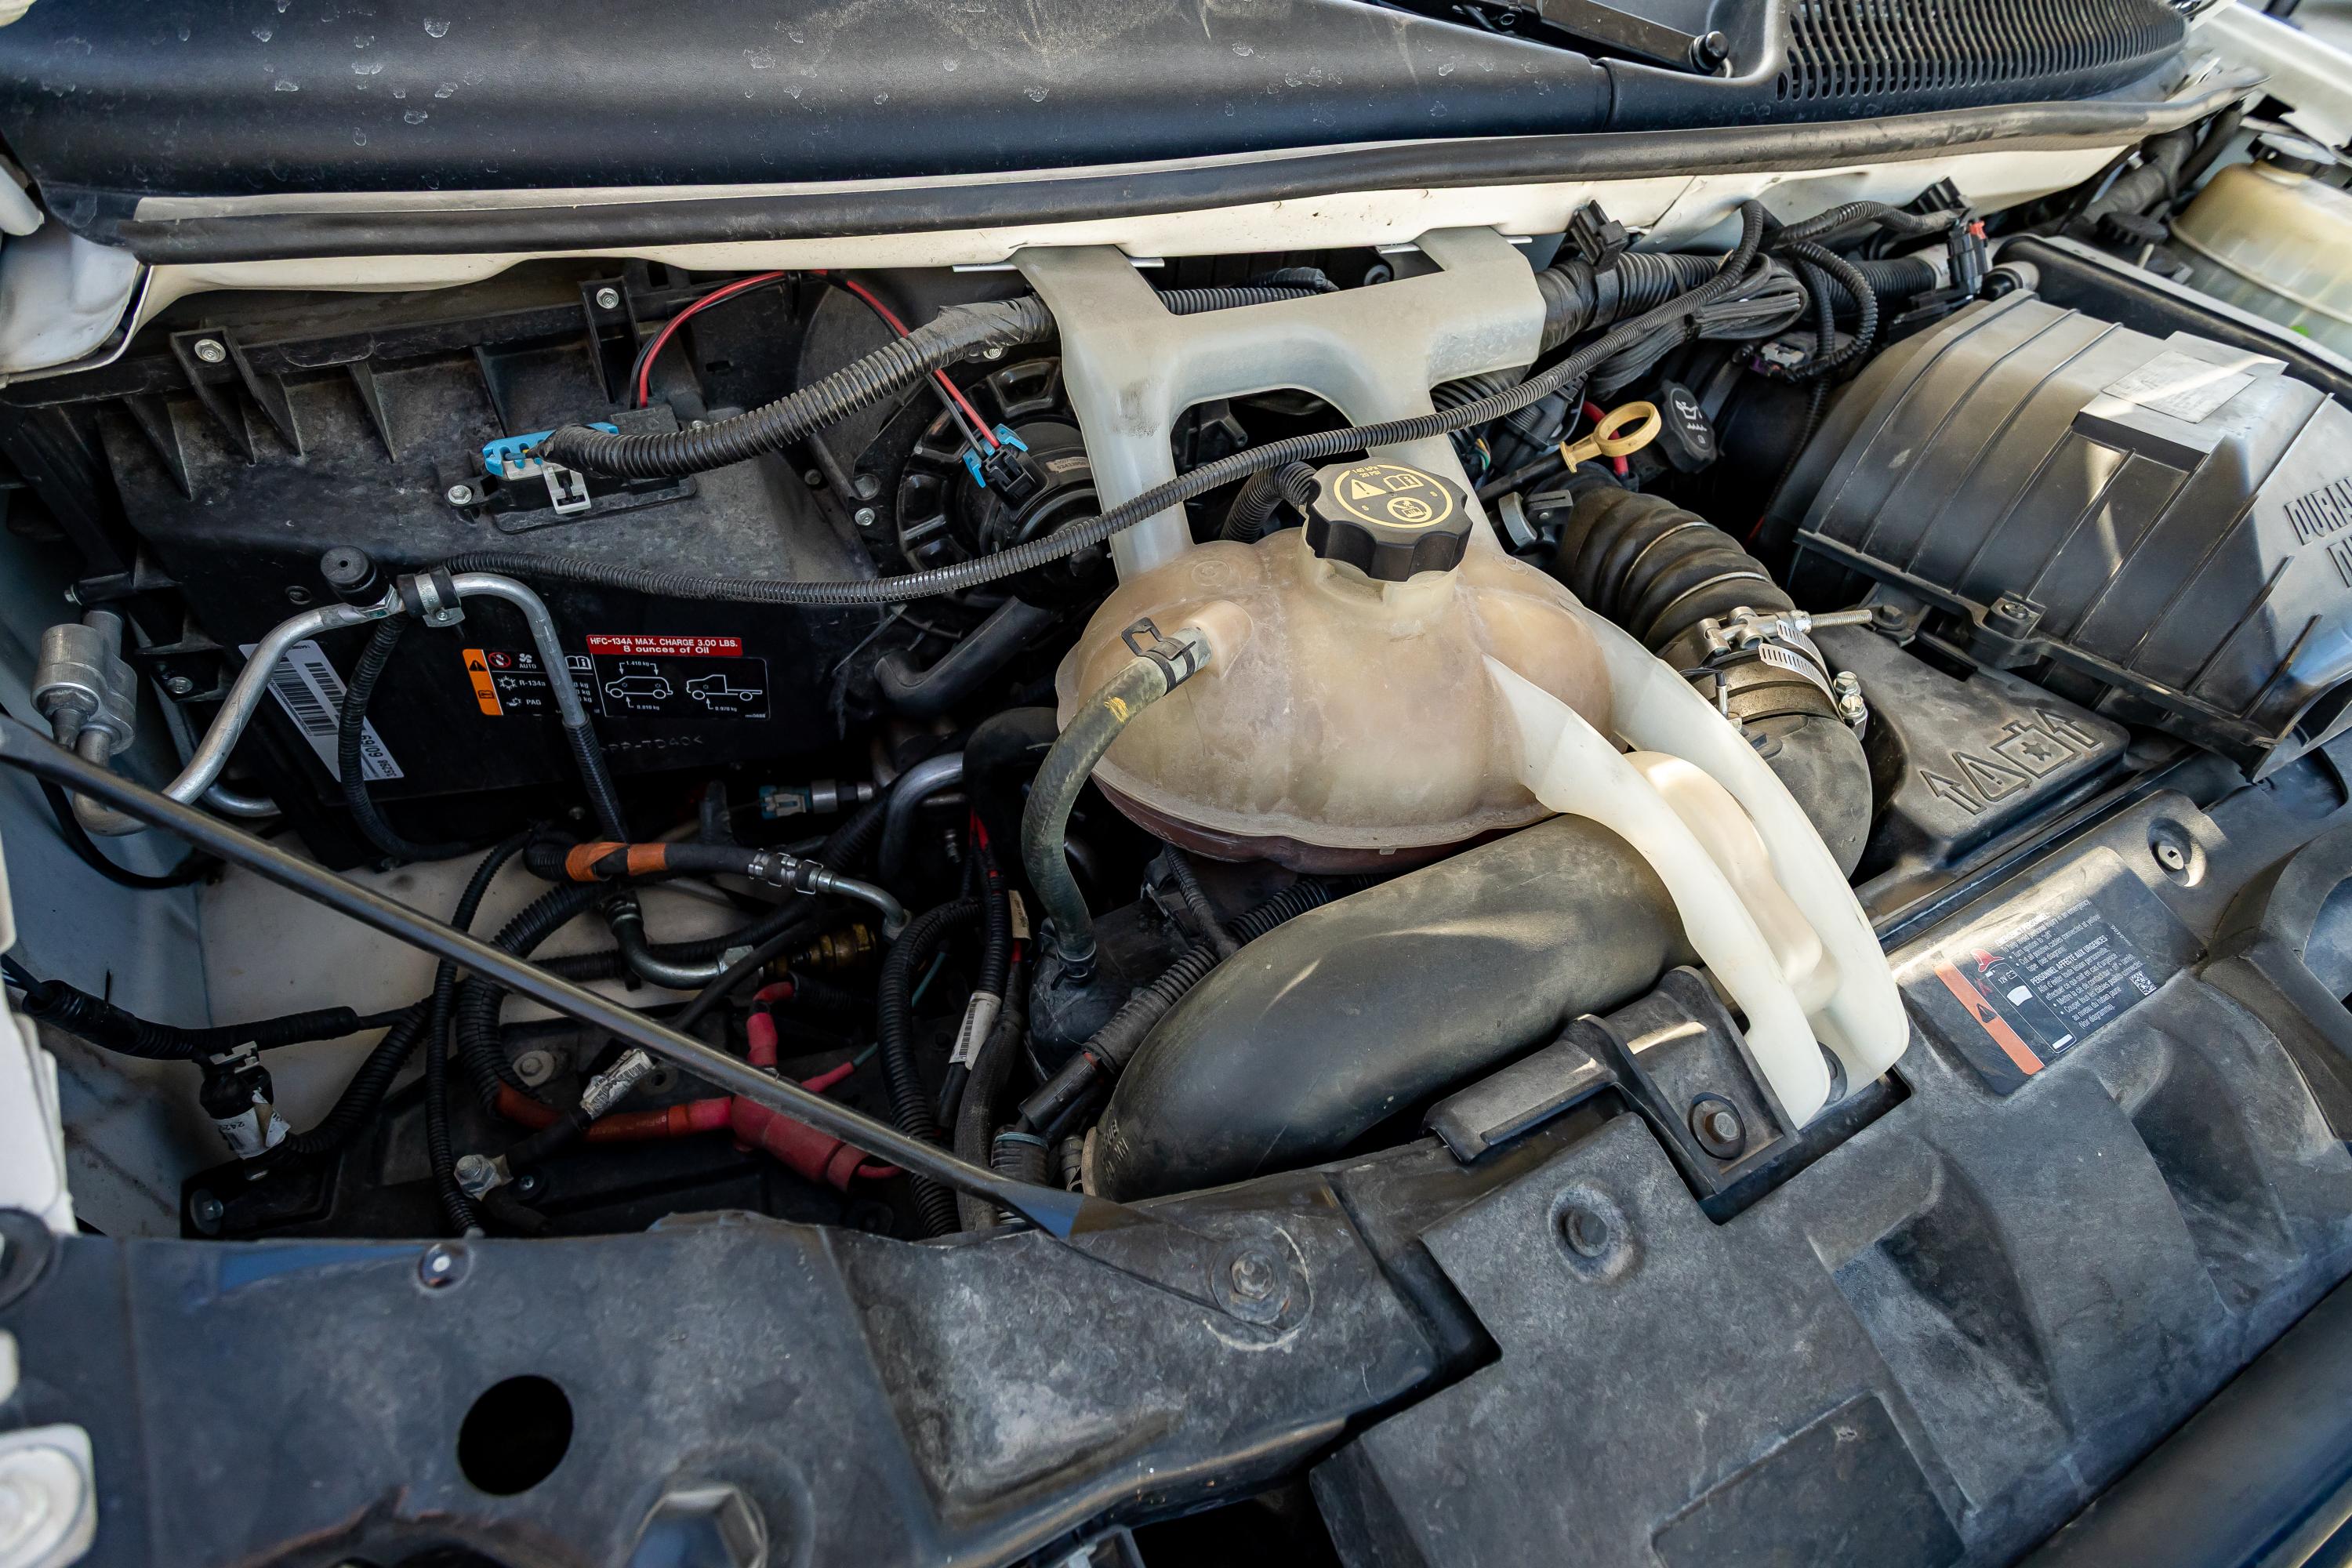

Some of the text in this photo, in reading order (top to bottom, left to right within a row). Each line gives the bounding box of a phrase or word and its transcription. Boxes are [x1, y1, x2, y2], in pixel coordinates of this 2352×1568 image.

[590, 637, 633, 646] HFC-134A
[697, 639, 717, 648] 3.00
[2018, 956, 2030, 965] Cut
[2032, 945, 2050, 958] positive
[2048, 936, 2063, 948] cables
[2061, 924, 2084, 940] connected
[2011, 949, 2024, 958] Turn
[2026, 963, 2038, 972] tape
[2030, 966, 2059, 985] PERSONNEL
[2056, 953, 2077, 970] AFFECTÉ
[2074, 948, 2086, 959] AUX
[2037, 985, 2049, 993] Afin
[2045, 985, 2065, 1001] effectuer
[2056, 993, 2073, 1005] Mettre
[2087, 972, 2105, 986] contact
[2063, 1000, 2081, 1013] Couper
[2078, 994, 2091, 1004] tous
[2078, 1005, 2093, 1017] niveau
[2096, 993, 2111, 1004] ruban
[2108, 986, 2122, 999] jaune
